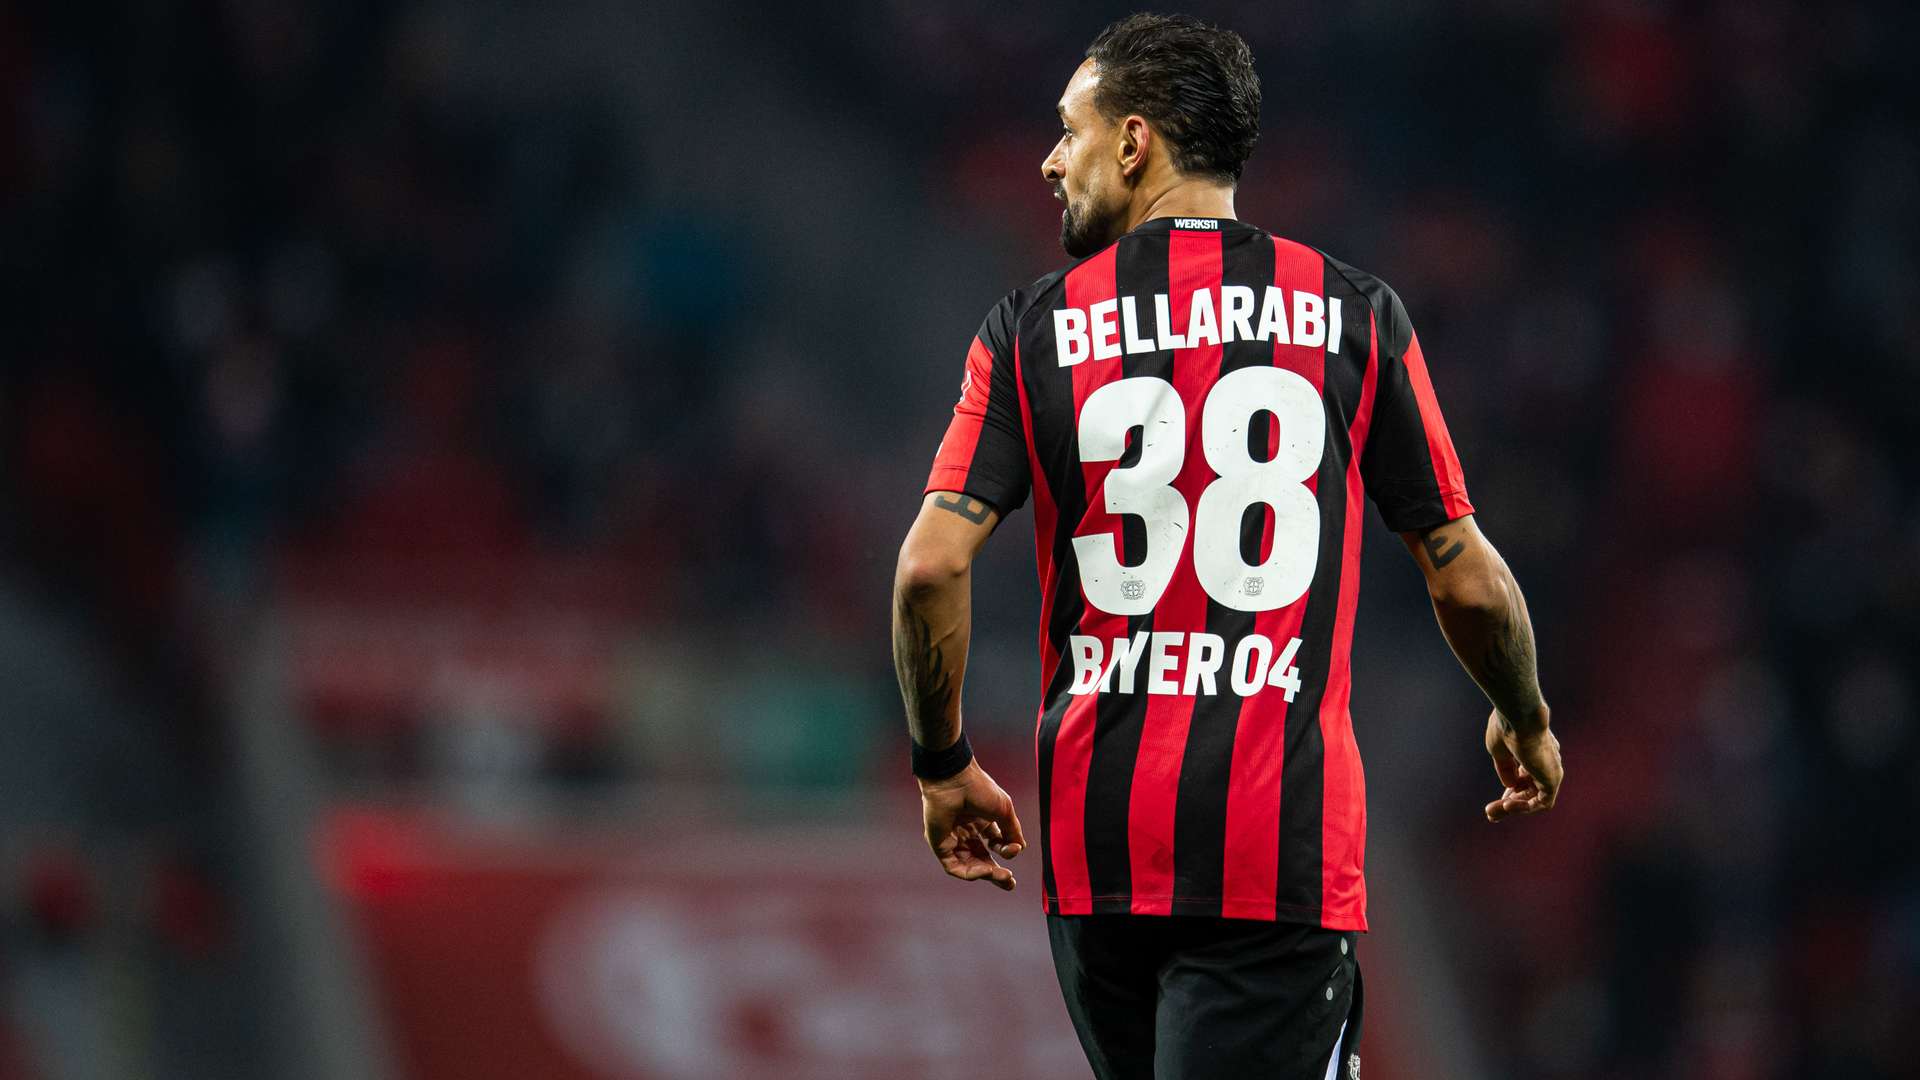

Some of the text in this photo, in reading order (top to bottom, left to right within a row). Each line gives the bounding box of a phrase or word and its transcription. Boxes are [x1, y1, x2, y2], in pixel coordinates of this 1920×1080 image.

[1053, 285, 1342, 367] BELLARABI
[1072, 366, 1326, 615] 38
[1230, 633, 1303, 703] 04
